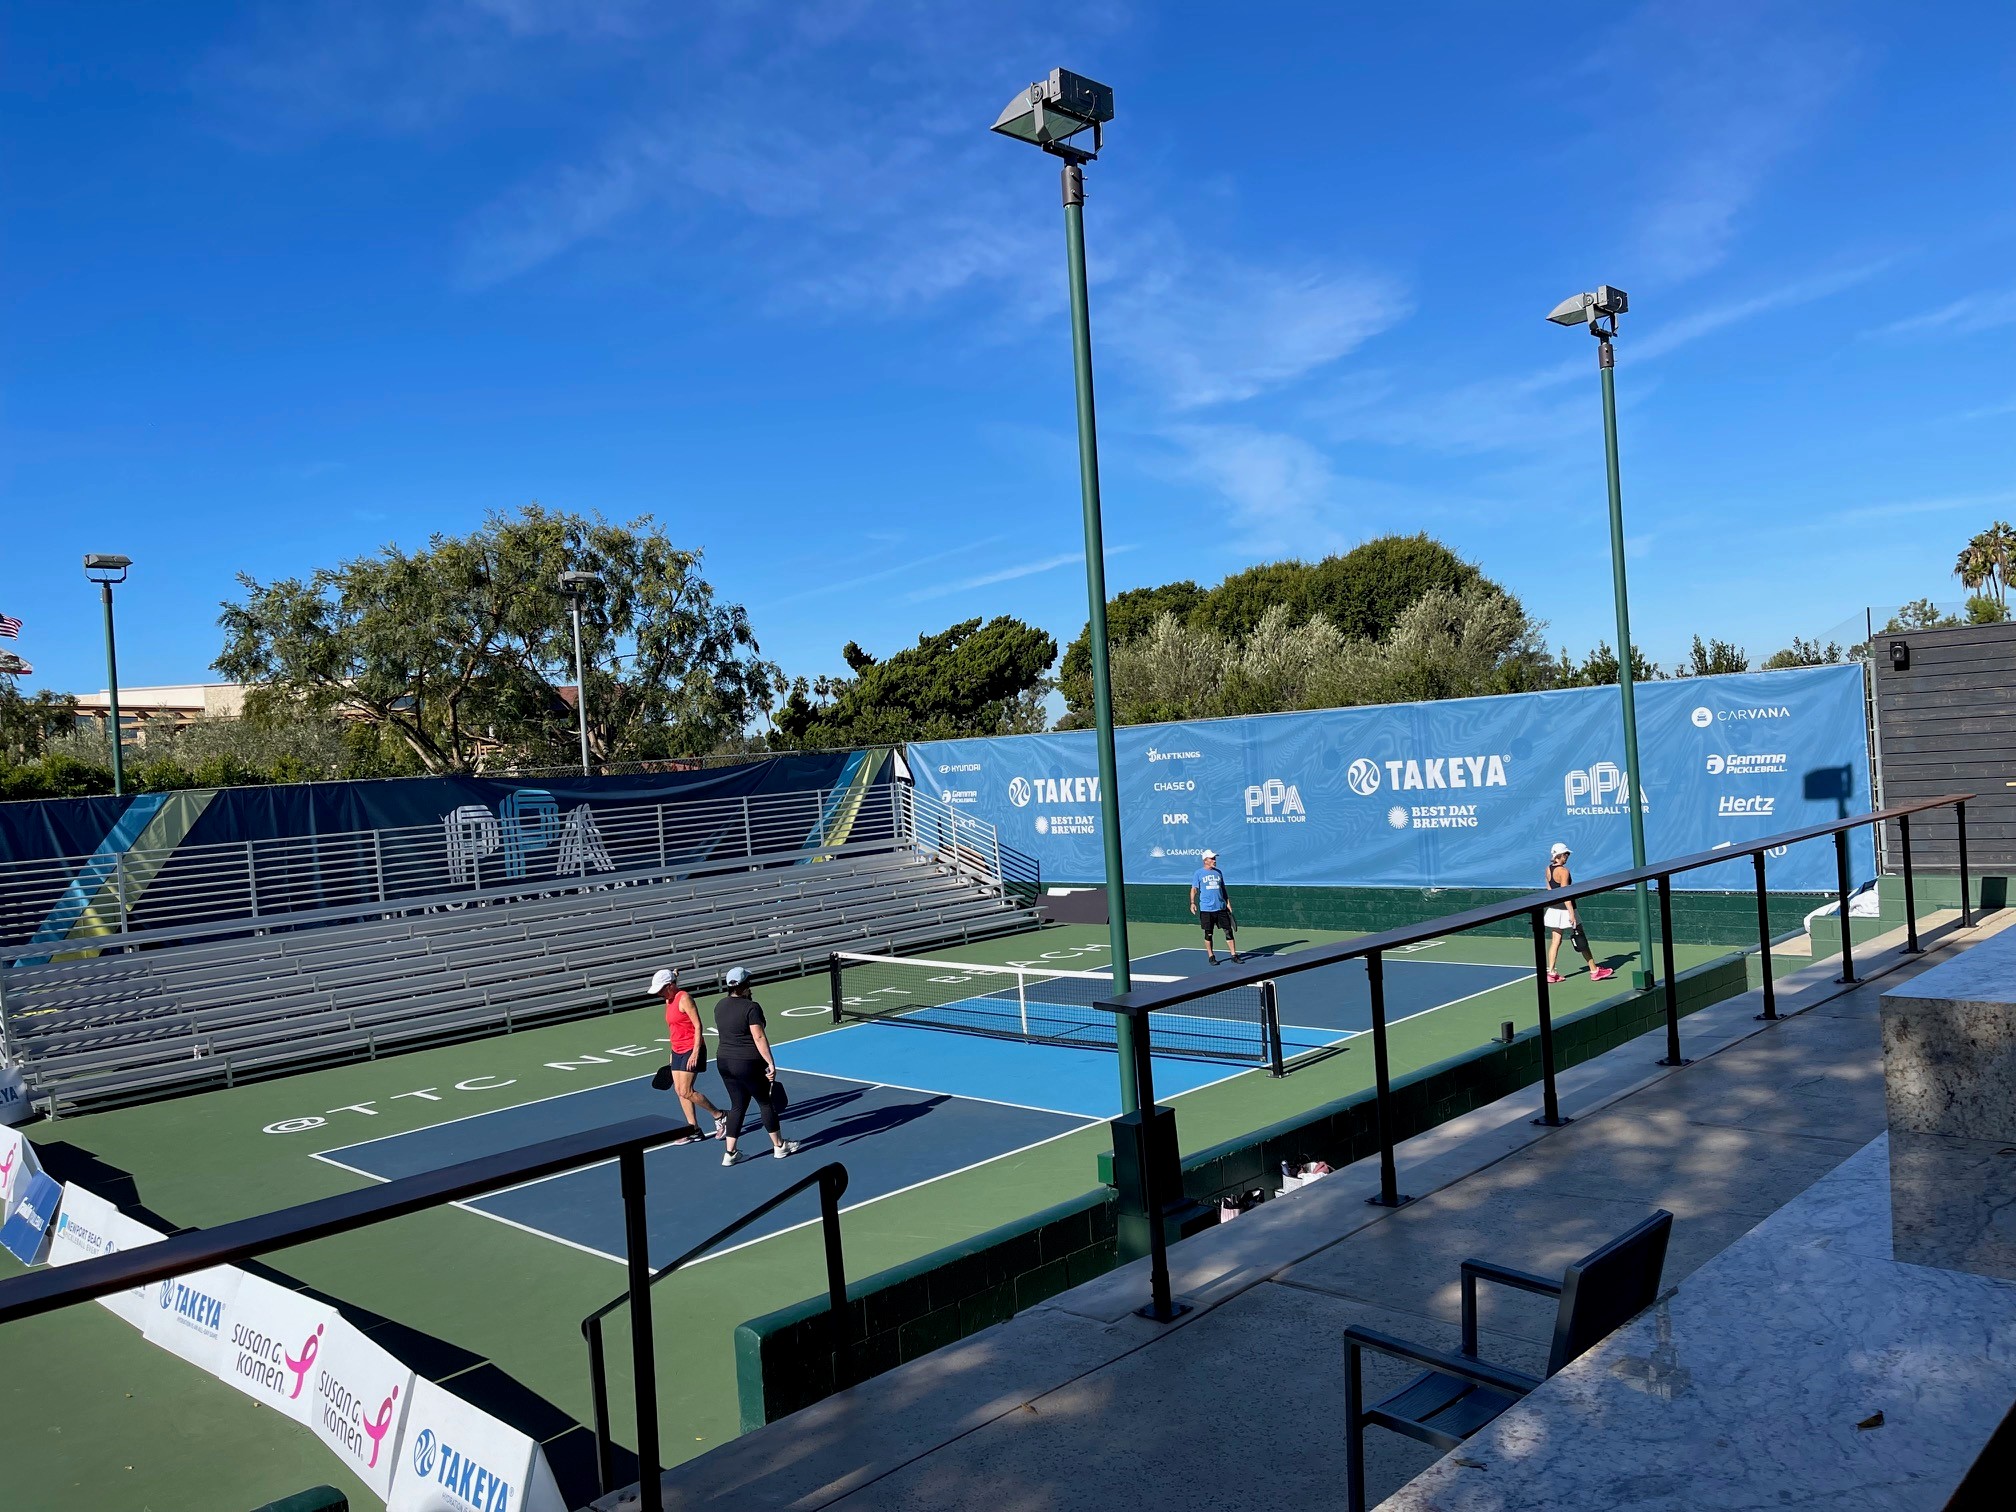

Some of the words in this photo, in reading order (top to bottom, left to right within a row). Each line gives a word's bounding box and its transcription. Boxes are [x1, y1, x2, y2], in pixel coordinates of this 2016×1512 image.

[1718, 706, 1790, 720] CARVANA
[1149, 751, 1200, 762] DRAFTKINGS
[1726, 754, 1786, 766] GAMMA
[951, 764, 980, 772] HYUNDAI
[1386, 754, 1507, 790] TAKEYA
[1034, 776, 1102, 804] TAKEY
[1154, 782, 1185, 791] CHASE
[1244, 778, 1306, 815] PPA
[1719, 795, 1774, 812] Hertz
[1411, 806, 1446, 816] BEST
[1449, 805, 1477, 816] DAY
[1567, 806, 1621, 815] PICKLEBALL
[1051, 816, 1073, 824] BEST
[1076, 816, 1094, 824] DAY
[1163, 814, 1189, 825] DUPR
[1412, 817, 1478, 828] BREWING
[1051, 825, 1094, 834] BREWING
[174, 1284, 222, 1330] TAKEYA
[438, 1443, 508, 1512] TAKEYA
